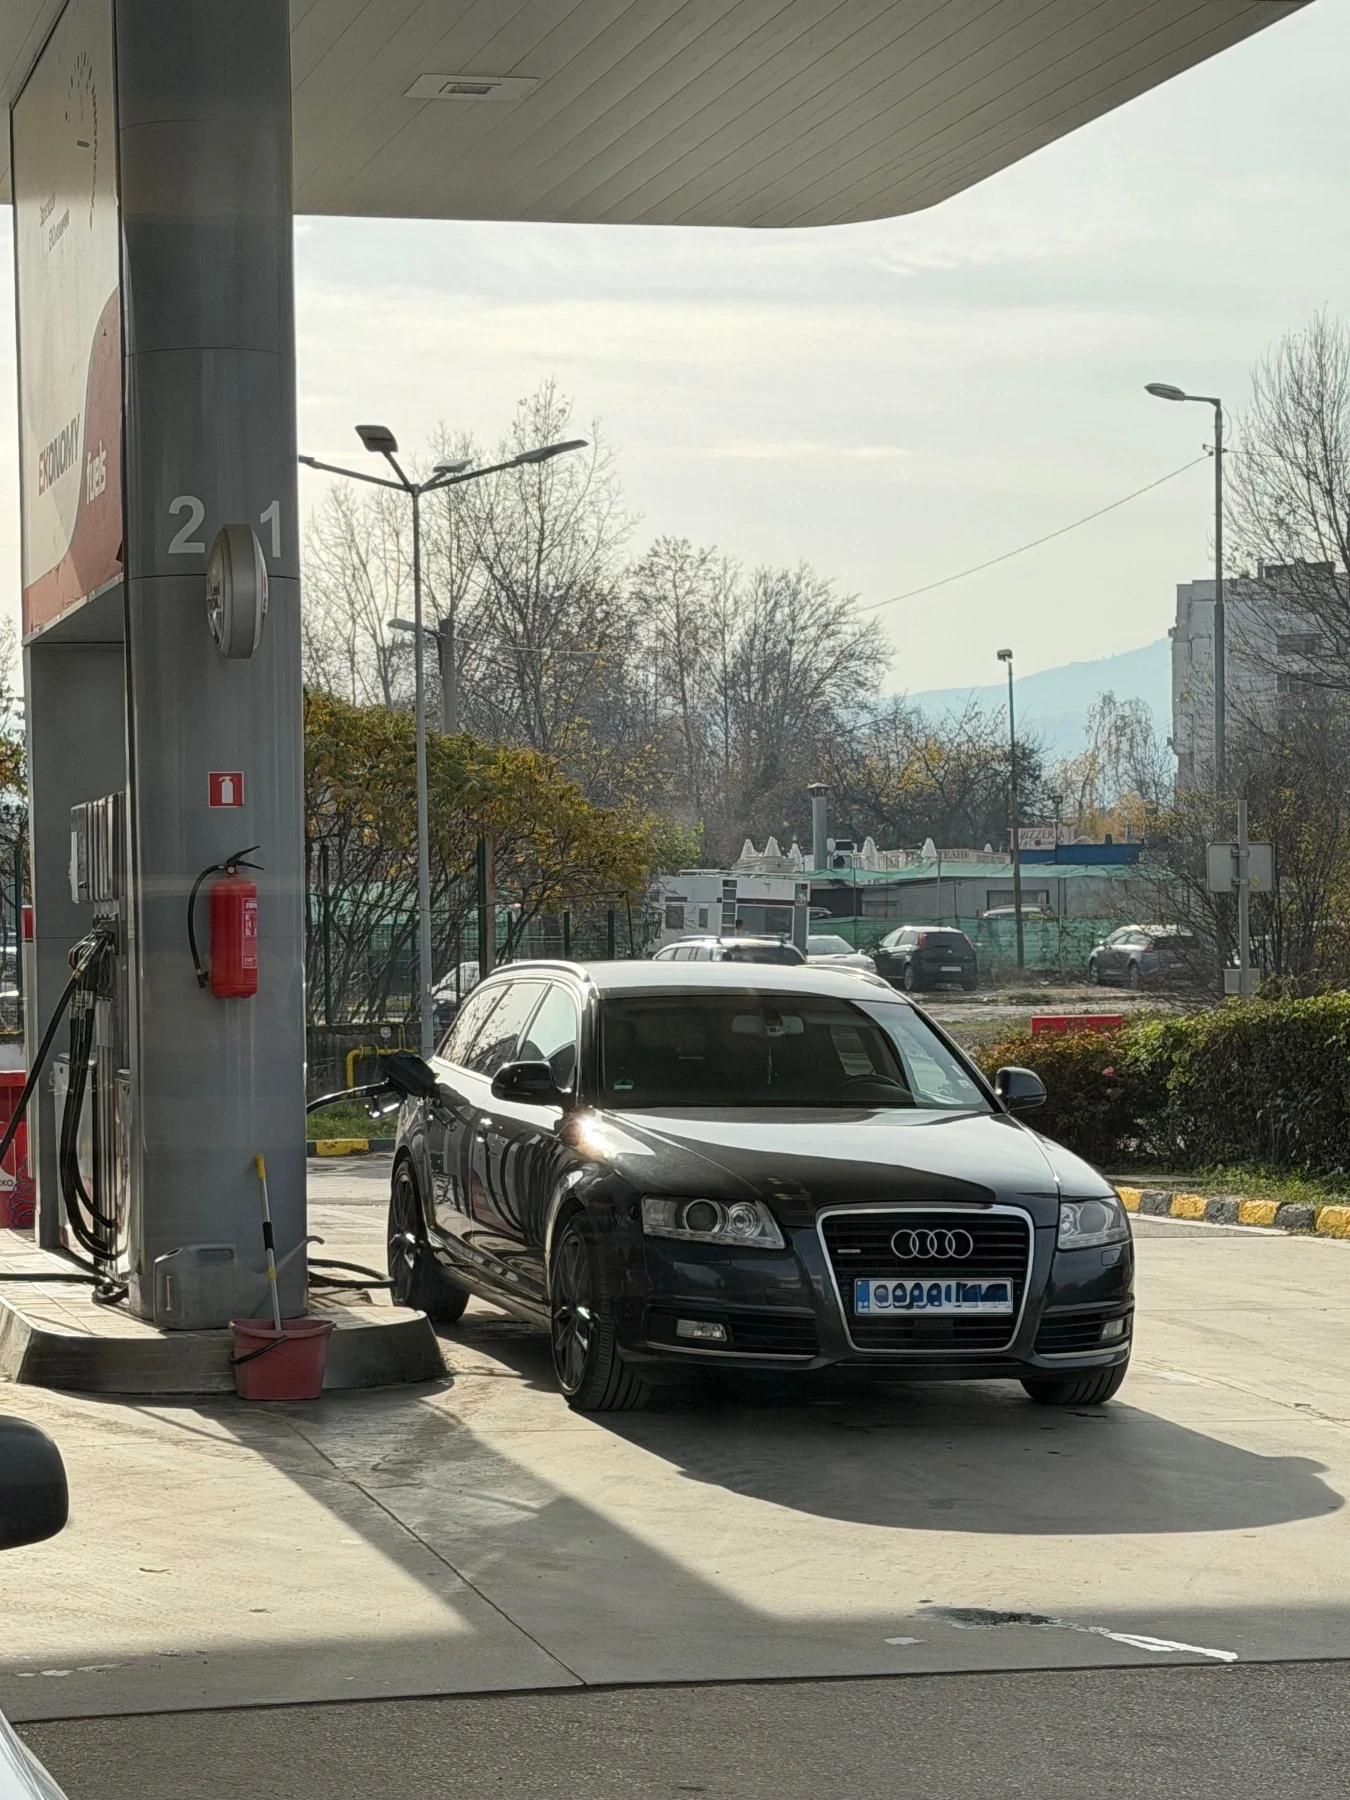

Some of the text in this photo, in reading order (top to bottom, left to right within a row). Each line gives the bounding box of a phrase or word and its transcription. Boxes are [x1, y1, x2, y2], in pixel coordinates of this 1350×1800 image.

[39, 412, 107, 505] EKONOMY fuels
[168, 495, 281, 558] 2 1
[1020, 829, 1064, 839] PIZZERA
